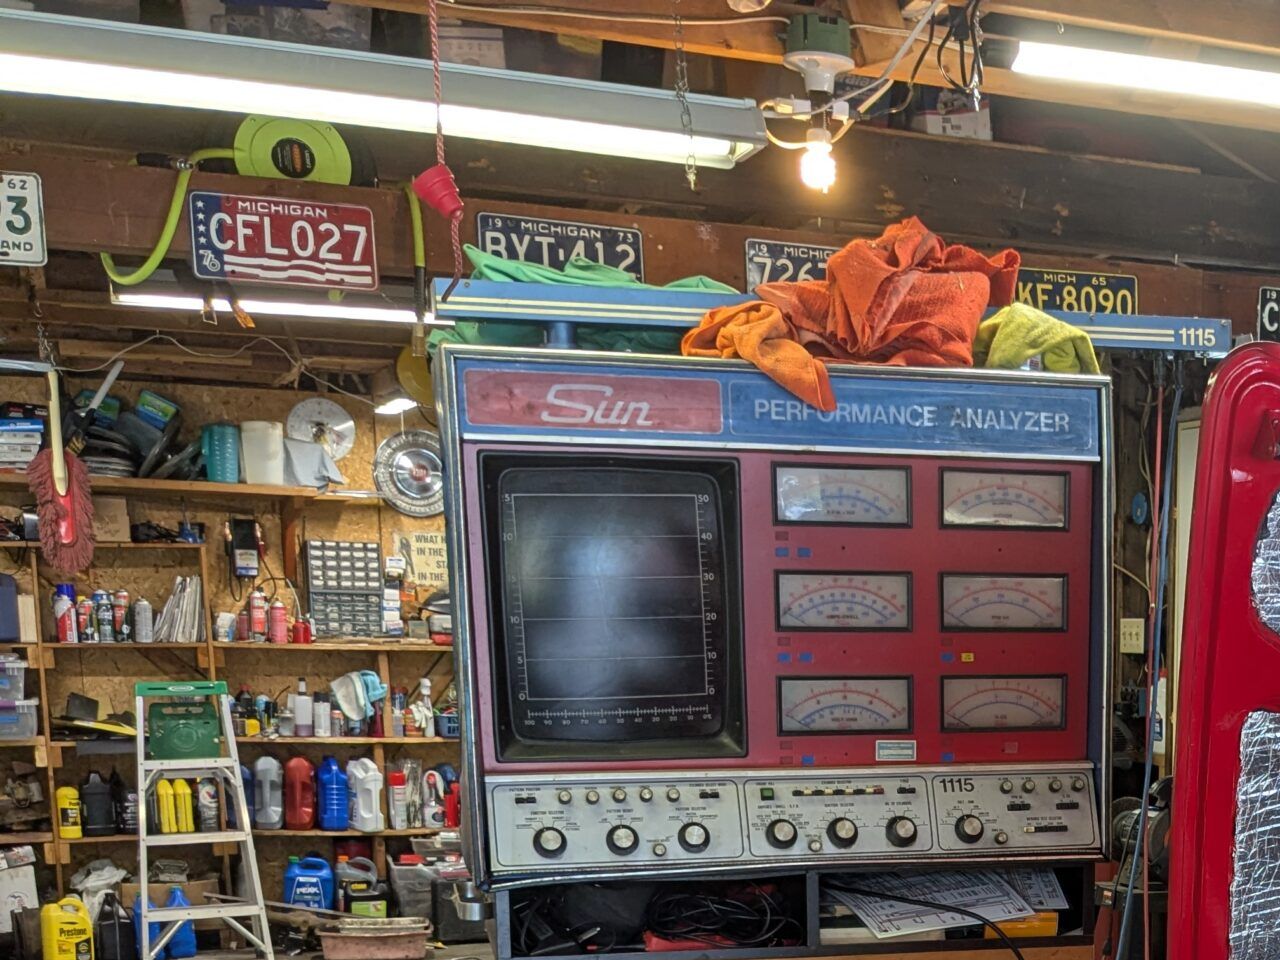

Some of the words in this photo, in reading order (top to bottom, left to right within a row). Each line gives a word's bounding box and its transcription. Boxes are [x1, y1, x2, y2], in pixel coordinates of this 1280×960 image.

[7, 179, 28, 190] 62
[237, 200, 327, 218] MICHIGAN
[488, 217, 502, 227] 19
[520, 221, 601, 239] MICHIGAN
[617, 231, 634, 243] 73
[209, 212, 368, 262] CFL027
[755, 243, 768, 254] 19
[783, 246, 834, 260] MICHIG
[1043, 273, 1076, 285] MICH
[1091, 276, 1107, 286] 65
[1266, 291, 1277, 299] 19
[1178, 327, 1216, 347] 1115
[541, 383, 653, 427] Sun
[754, 399, 938, 427] PERFORMANCE
[950, 407, 1070, 433] ANALYZER
[698, 494, 709, 503] 50
[414, 534, 439, 544] WHAT
[701, 532, 713, 540] 40
[416, 547, 426, 556] IN
[429, 548, 444, 557] THE
[418, 572, 428, 581] IN
[430, 572, 445, 581] THE
[703, 573, 714, 581] 30
[511, 615, 520, 624] 10
[708, 651, 717, 659] 10
[708, 687, 715, 695] 0
[518, 692, 526, 701] 0
[939, 778, 975, 793] 1115
[59, 927, 87, 937] Prestone
